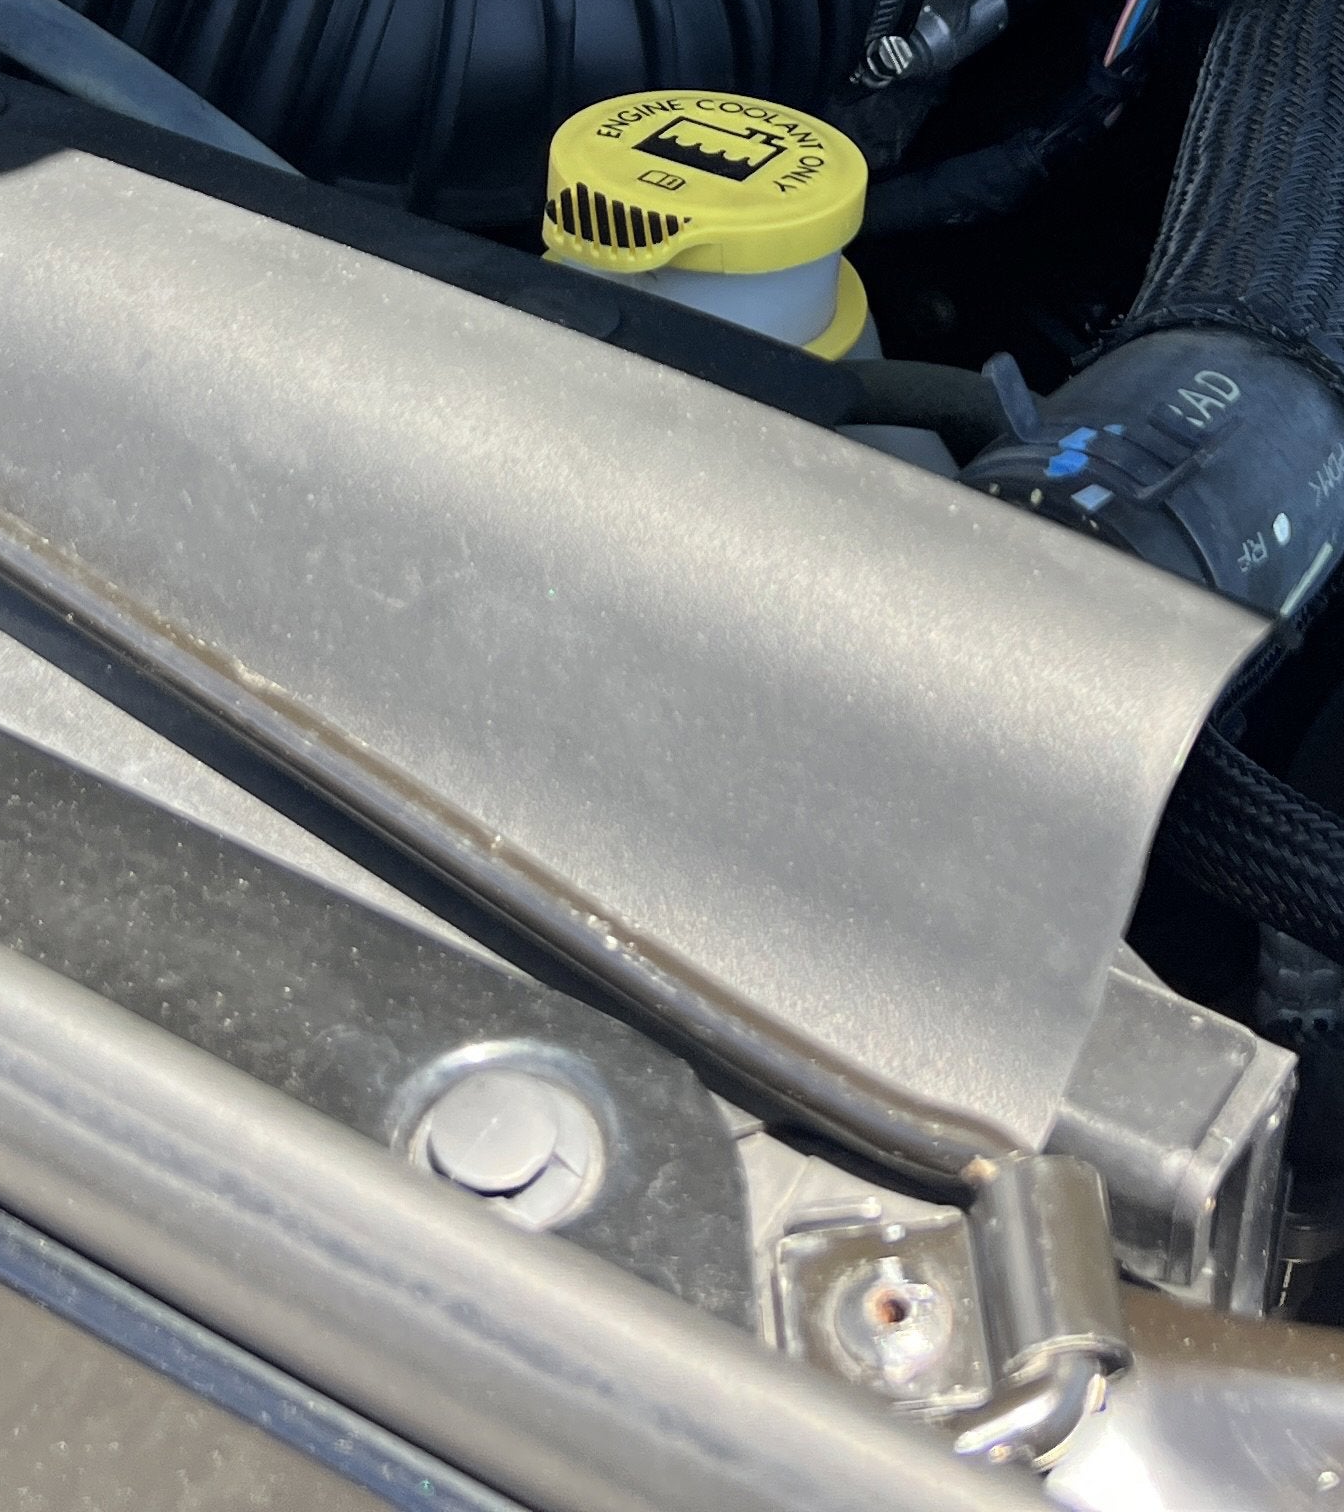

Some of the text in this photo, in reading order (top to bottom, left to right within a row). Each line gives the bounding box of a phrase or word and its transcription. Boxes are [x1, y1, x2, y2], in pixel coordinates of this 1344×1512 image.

[597, 99, 826, 194] ENGINE COOLANT ONLY
